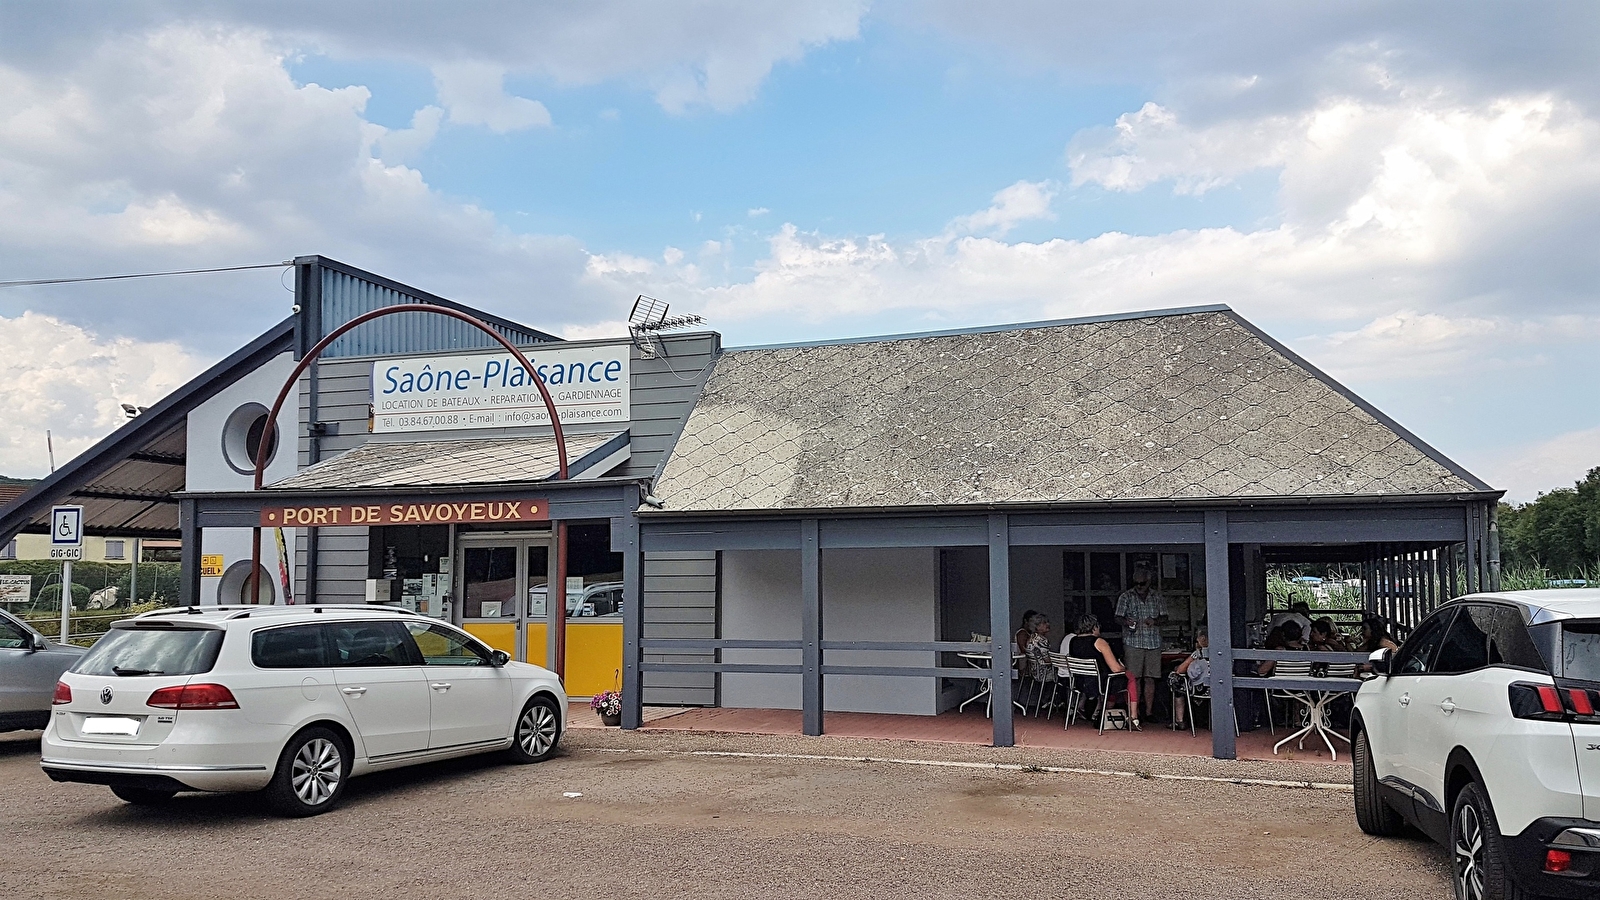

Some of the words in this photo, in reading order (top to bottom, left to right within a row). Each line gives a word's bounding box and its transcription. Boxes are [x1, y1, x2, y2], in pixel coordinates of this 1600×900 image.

[382, 357, 622, 394] Saône-Plaisance
[381, 399, 424, 410] LOCATION
[426, 397, 438, 408] DE
[441, 396, 481, 408] BATEAUX
[558, 388, 622, 401] GARDIENNAGE
[382, 417, 395, 427] Tél.
[398, 414, 459, 427] 03.84.67.00.88
[469, 412, 495, 424] E-mail
[504, 407, 622, 422] info@sao-plaisance.com
[282, 507, 342, 525] PORT
[350, 505, 382, 523] DE
[389, 501, 522, 523] SAVOYEUX
